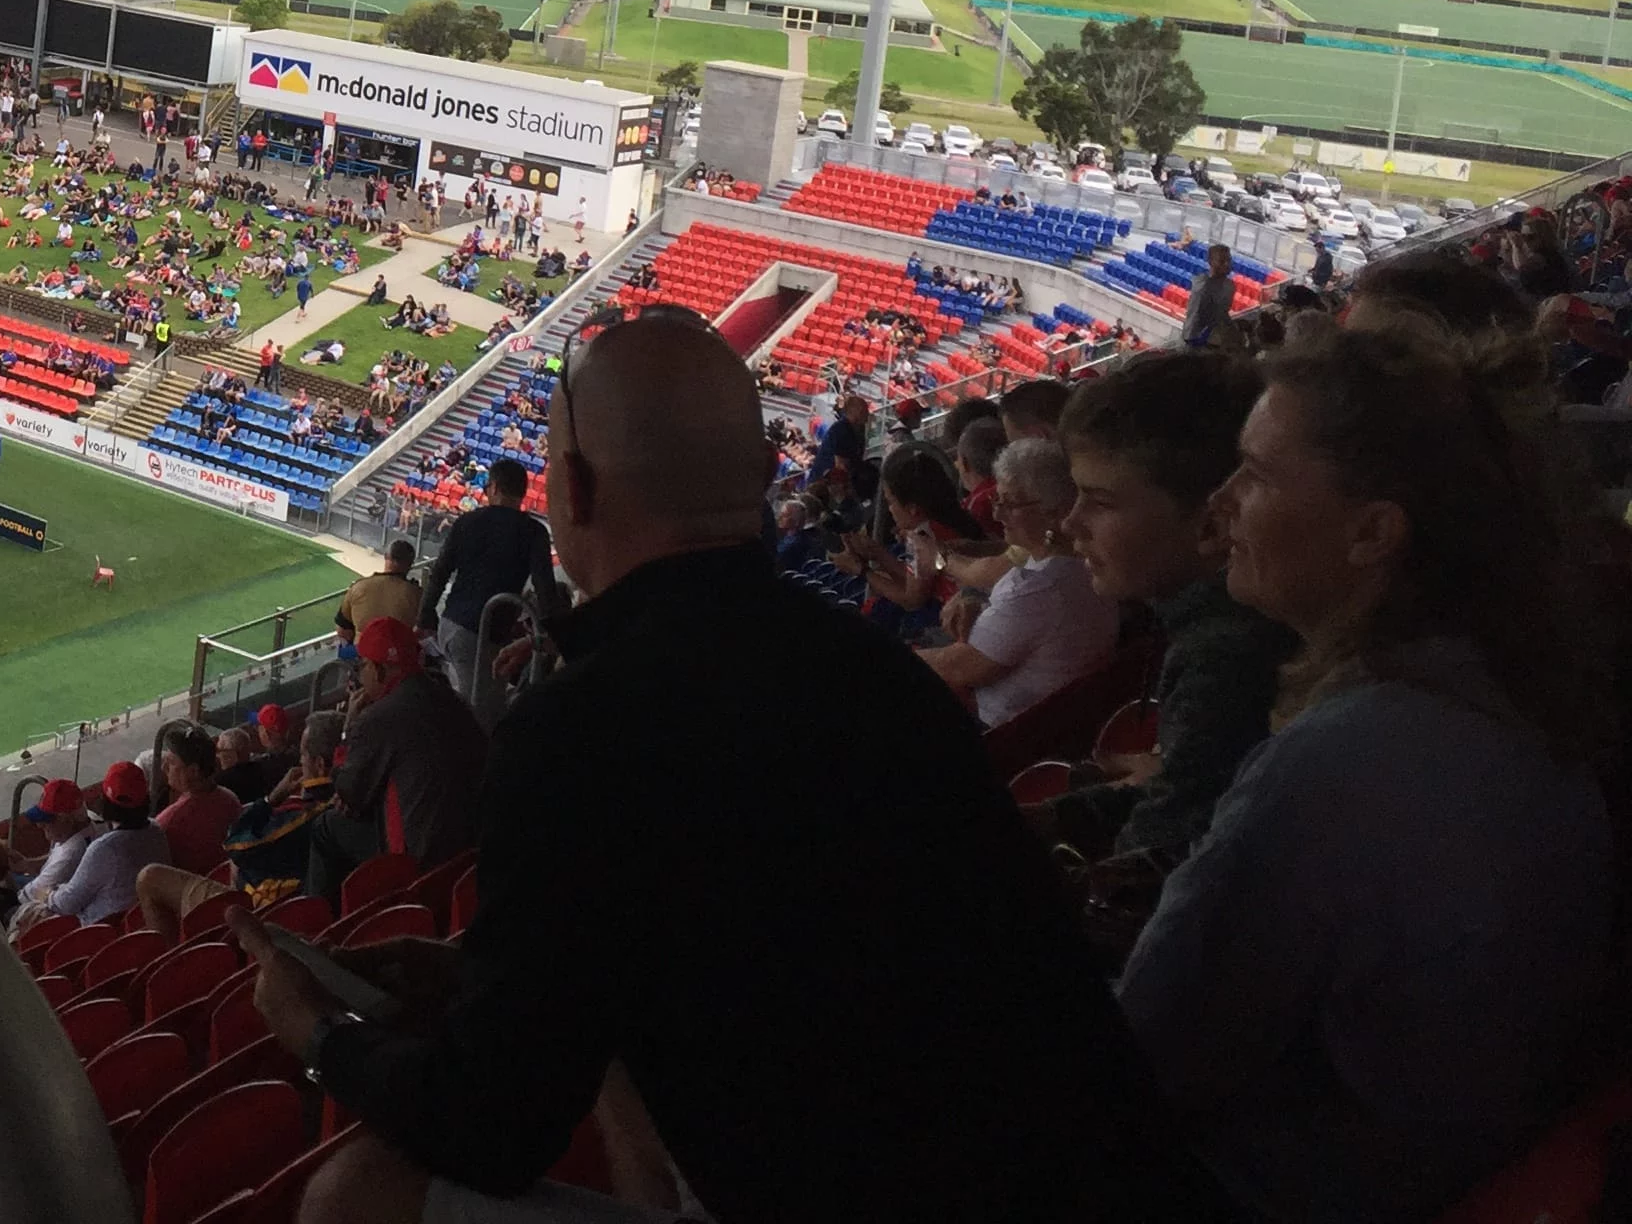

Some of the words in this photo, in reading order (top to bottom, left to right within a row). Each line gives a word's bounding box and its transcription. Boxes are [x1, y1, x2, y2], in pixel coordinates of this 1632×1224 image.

[317, 73, 429, 111] mcdonald
[432, 89, 499, 124] jones
[506, 105, 603, 145] stadium
[16, 416, 54, 438] variety
[87, 441, 128, 462] variety
[243, 483, 277, 503] PLUS
[0, 516, 34, 537] FOOTBALL
